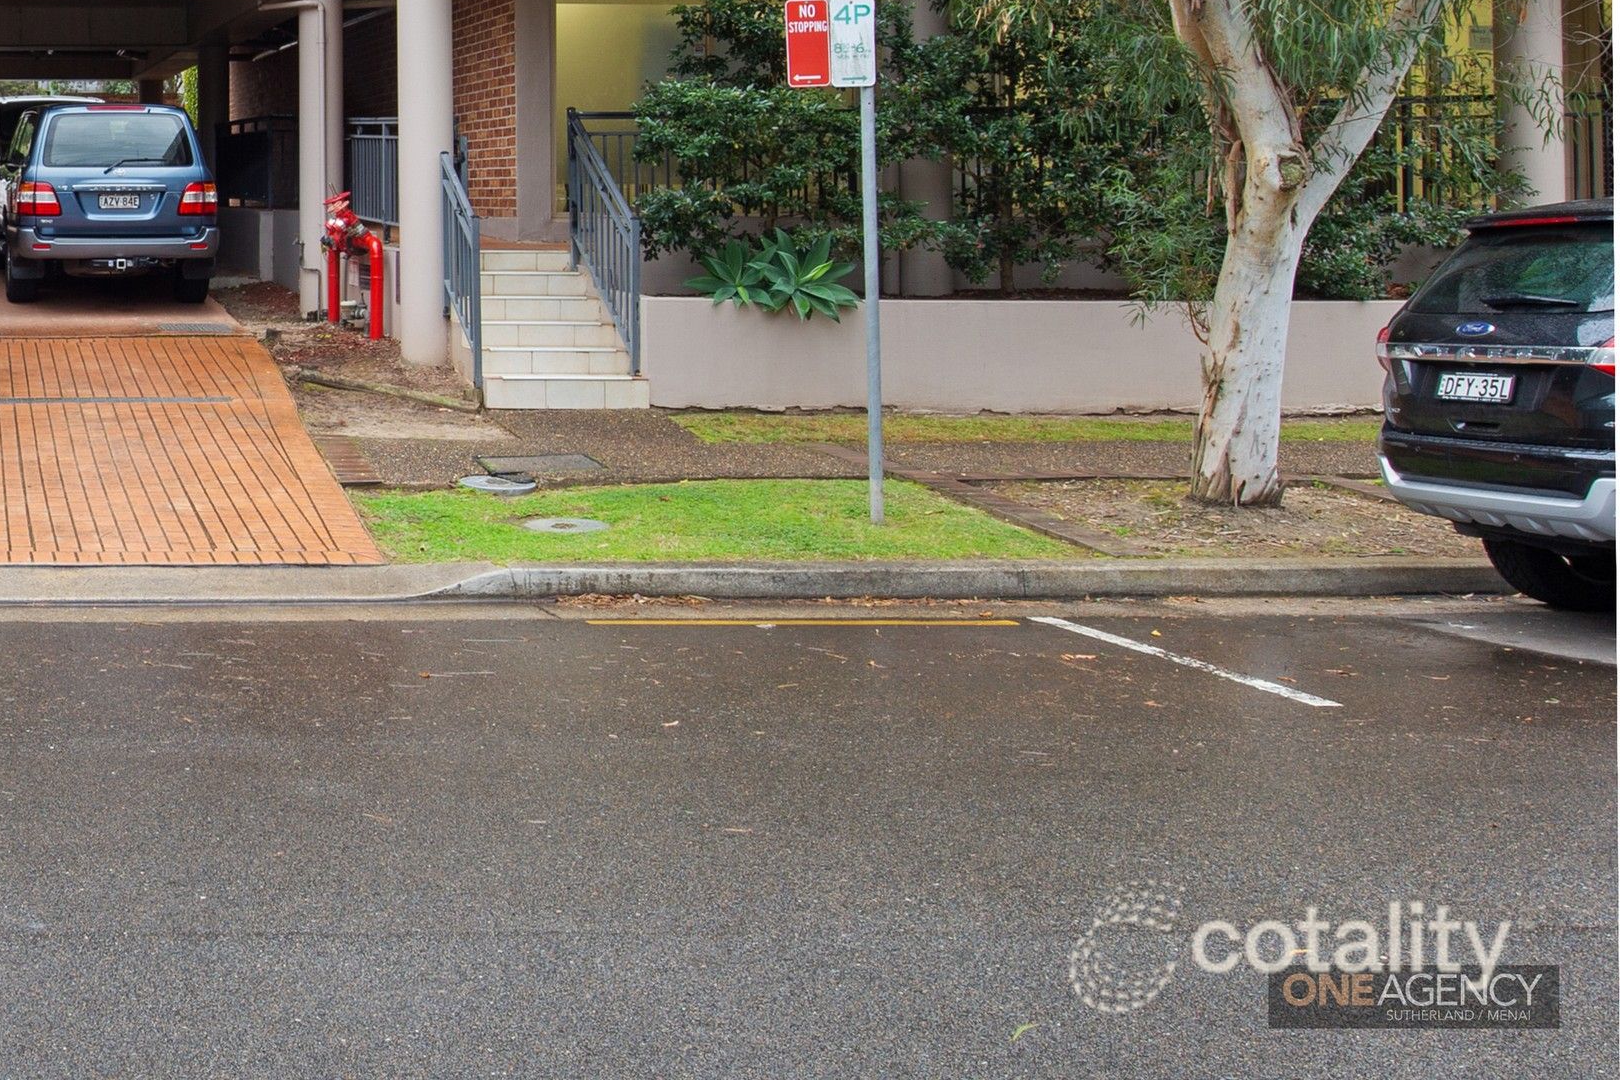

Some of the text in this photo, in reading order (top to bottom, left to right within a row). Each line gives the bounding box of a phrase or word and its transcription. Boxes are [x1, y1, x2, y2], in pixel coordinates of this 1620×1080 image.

[799, 4, 816, 19] NO
[833, 4, 871, 25] 4P
[788, 20, 828, 33] STOPPING
